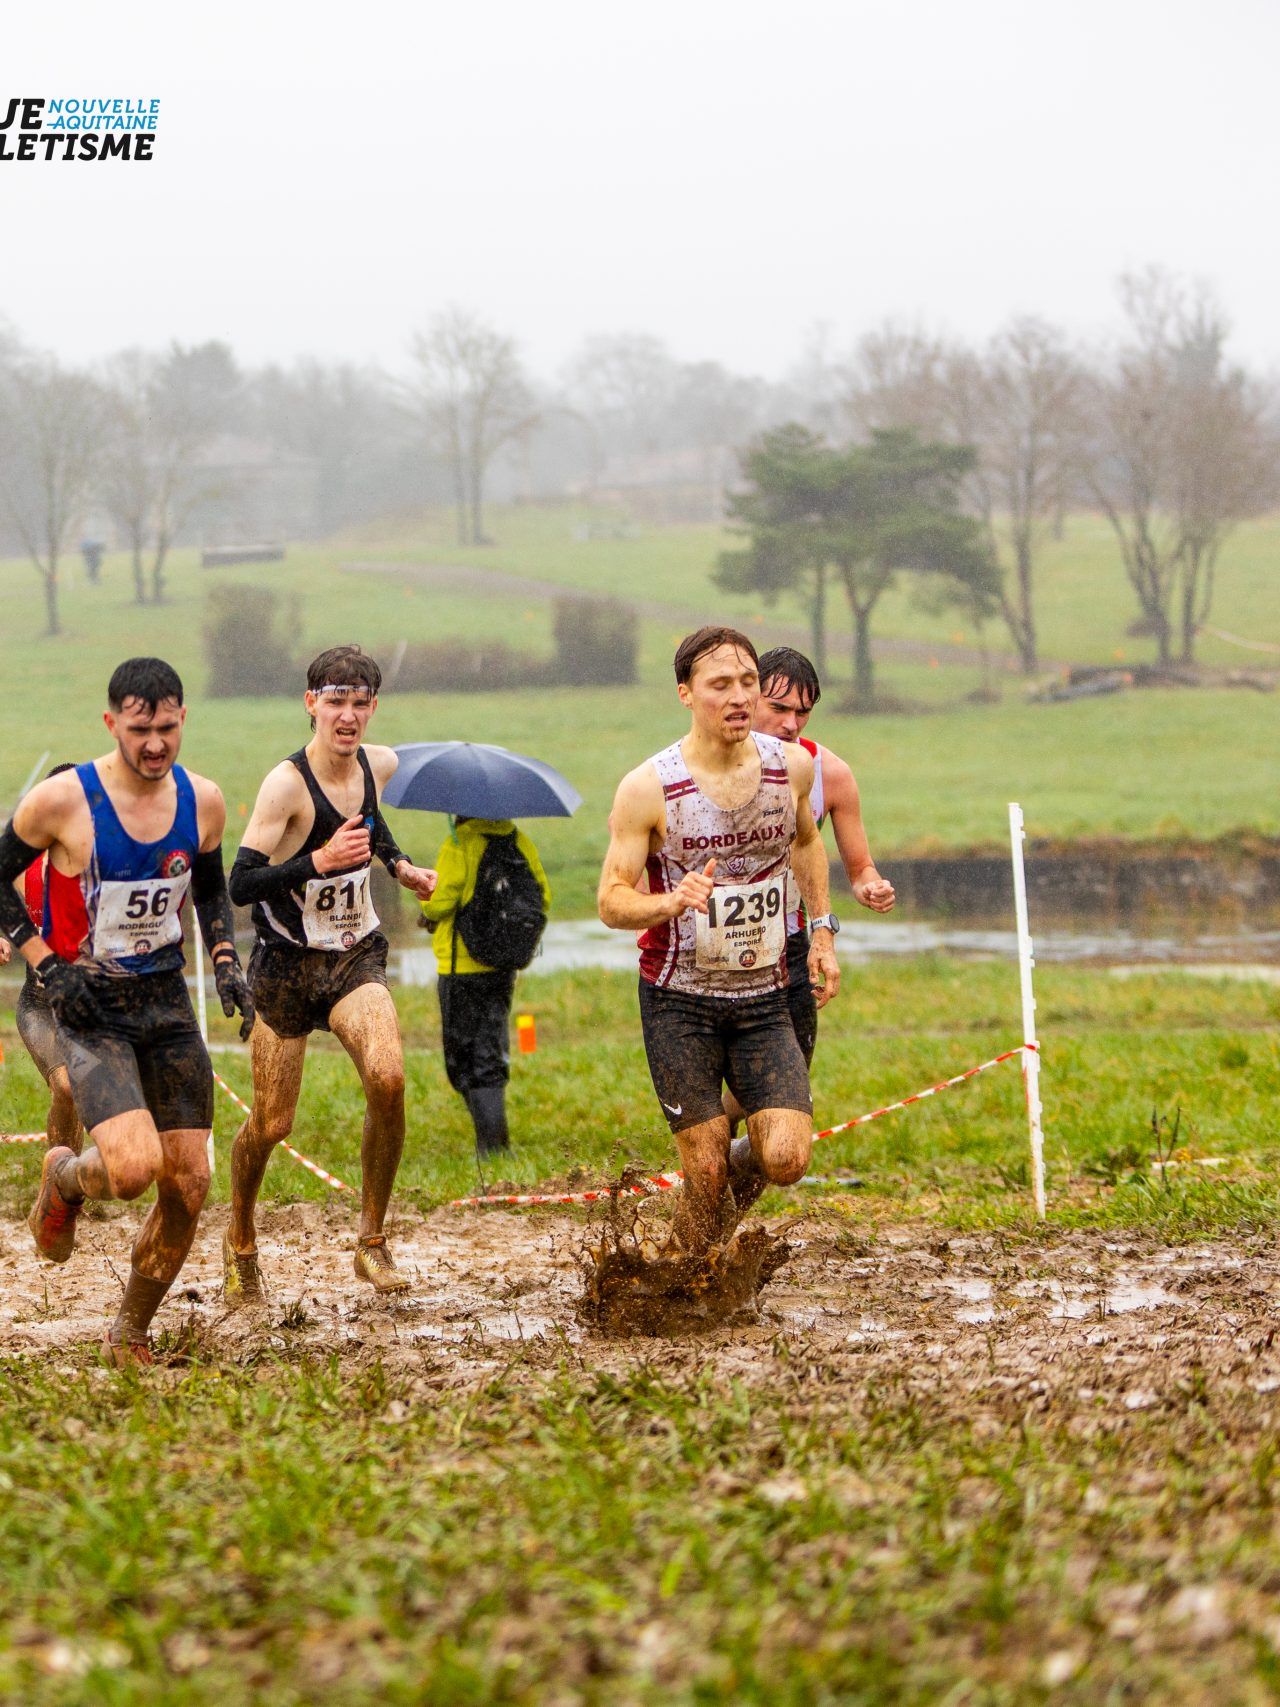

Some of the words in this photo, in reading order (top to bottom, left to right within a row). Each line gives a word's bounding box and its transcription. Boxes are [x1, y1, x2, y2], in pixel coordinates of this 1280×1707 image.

[682, 824, 785, 851] BORDEAUX
[125, 887, 172, 919] 56
[707, 887, 781, 929] 1239
